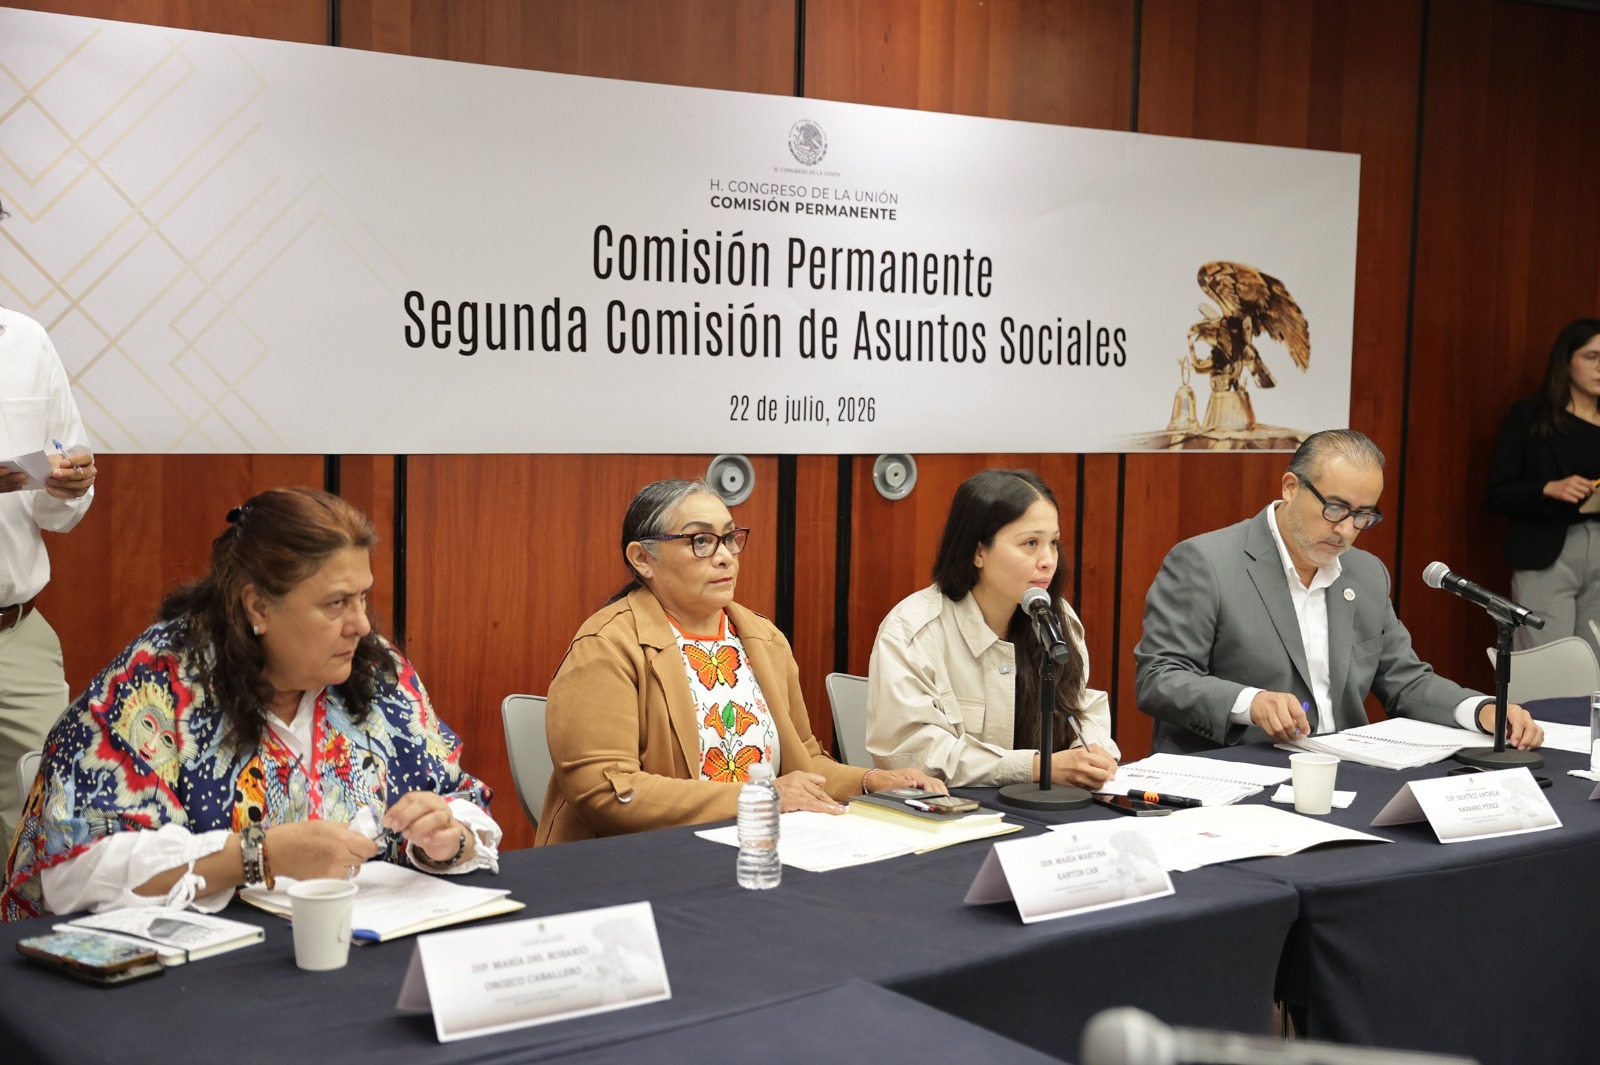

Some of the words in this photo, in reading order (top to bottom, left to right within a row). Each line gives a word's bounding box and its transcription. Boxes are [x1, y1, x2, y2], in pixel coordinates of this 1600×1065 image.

[710, 179, 723, 192] H.
[728, 180, 807, 198] CONGRESO
[812, 187, 829, 199] DE
[834, 189, 851, 201] LA
[855, 190, 898, 204] UNIÓN
[711, 195, 789, 213] COMISIÓN
[795, 202, 897, 220] PERMANENTE
[593, 224, 770, 287] Comisión
[787, 237, 993, 298] Permanente
[404, 290, 588, 356] Segunda
[606, 300, 781, 358] Comisión
[799, 308, 838, 359] de
[853, 311, 987, 364] Asuntos
[1000, 316, 1127, 367] Sociales
[730, 395, 750, 421] 22
[756, 395, 778, 421] de
[784, 396, 830, 426] julio,
[838, 396, 876, 422] 2026
